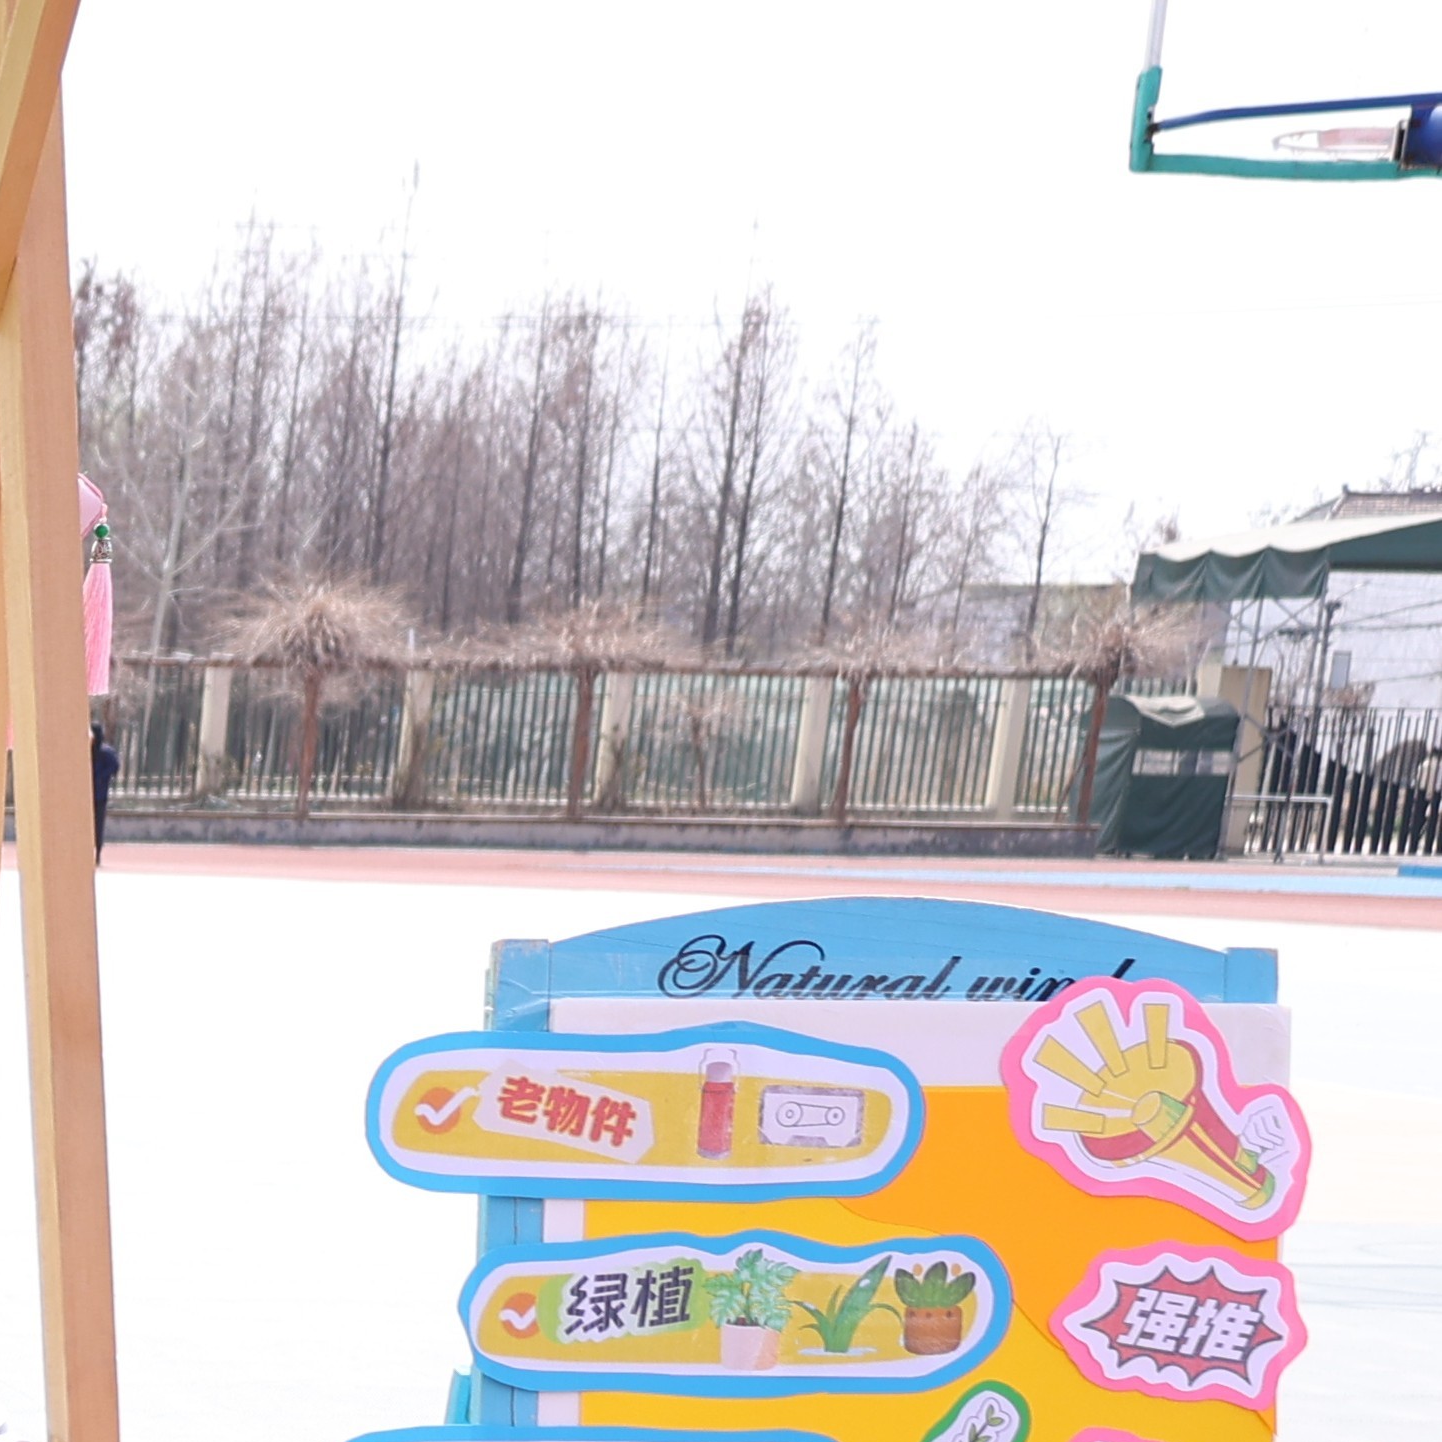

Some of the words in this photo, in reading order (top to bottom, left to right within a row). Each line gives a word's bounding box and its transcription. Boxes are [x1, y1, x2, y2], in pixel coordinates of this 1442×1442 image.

[657, 933, 962, 1001] Natural
[964, 957, 1137, 1002] win
[494, 1074, 639, 1149] 老物件
[562, 1264, 694, 1339] 绿植
[1115, 1286, 1263, 1366] 强推
